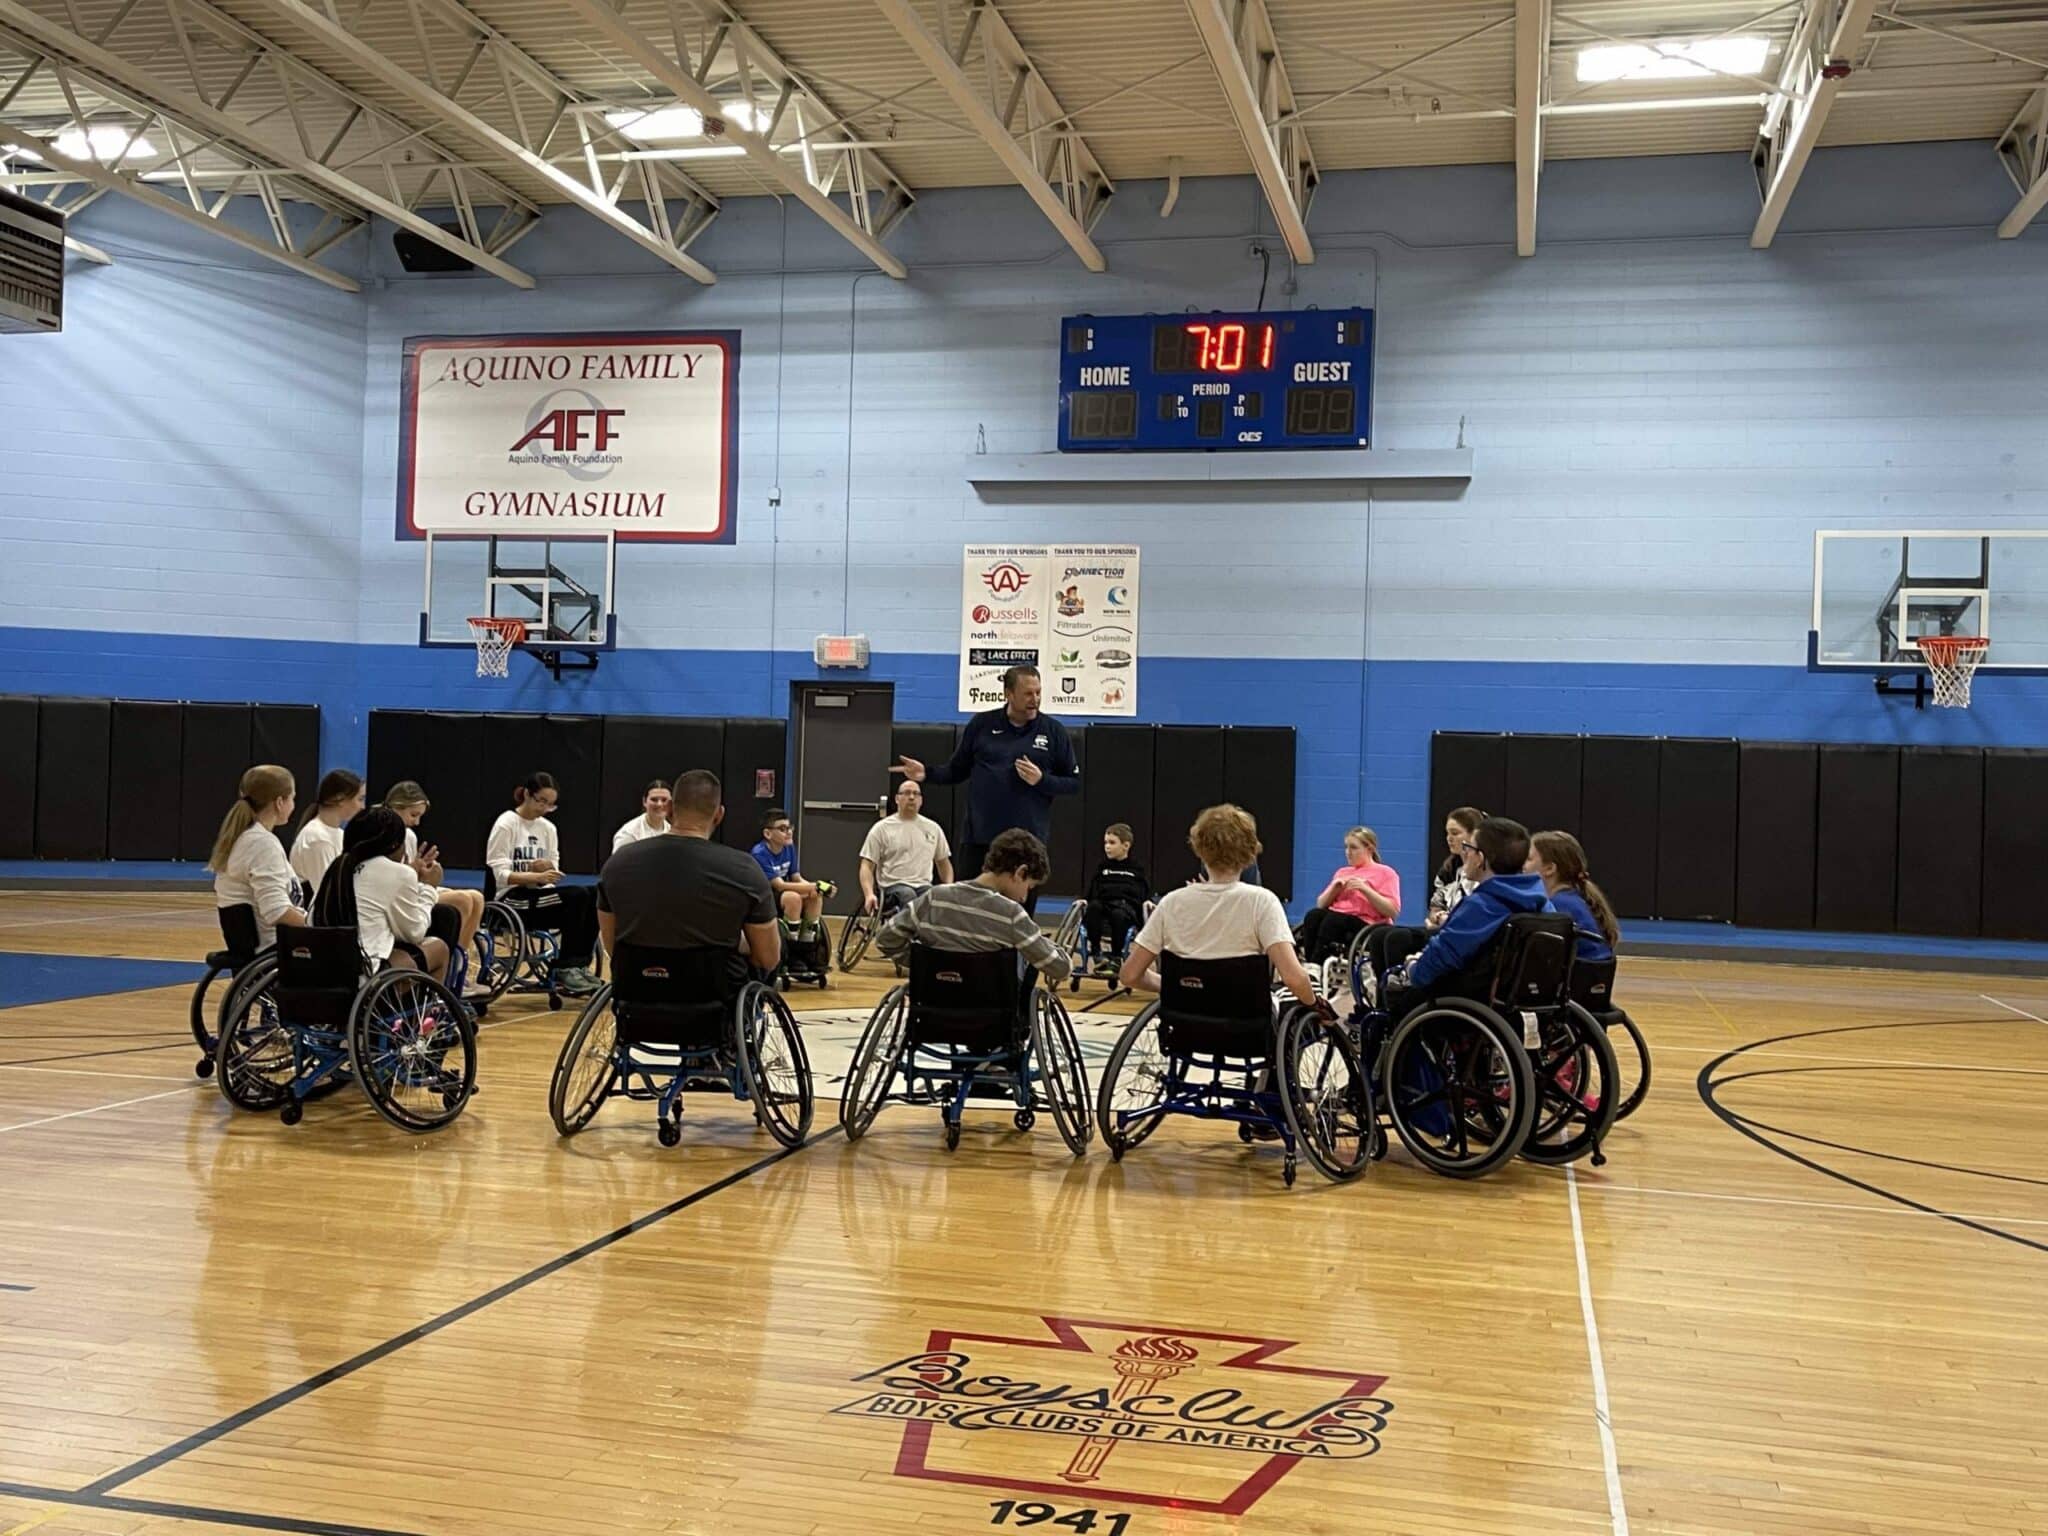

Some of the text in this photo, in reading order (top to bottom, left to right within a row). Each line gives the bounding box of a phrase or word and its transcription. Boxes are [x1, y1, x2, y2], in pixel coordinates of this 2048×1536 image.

[1187, 325, 1273, 371] 7:01
[439, 353, 703, 388] AQUINO FAMILY
[1080, 366, 1130, 387] HOME
[1294, 361, 1351, 383] GUEST
[1192, 383, 1231, 397] PERIOD
[1177, 395, 1185, 406] P
[1239, 394, 1246, 405] P
[1177, 407, 1189, 418] TO
[1232, 406, 1245, 417] TO
[509, 409, 625, 451] AFF
[508, 454, 623, 465] Aquino Family Foundation
[465, 491, 667, 518] GYMNASIUM
[972, 605, 1038, 624] Russells
[1056, 621, 1092, 629] Filtration
[970, 629, 998, 640] north
[987, 650, 1036, 661] LAKE EFFECT
[1051, 696, 1085, 704] SWITZER
[983, 1409, 1104, 1434] CLUBS
[1111, 1421, 1159, 1437] OF
[1166, 1427, 1332, 1456] AMERICA
[990, 1500, 1132, 1536] 1941
